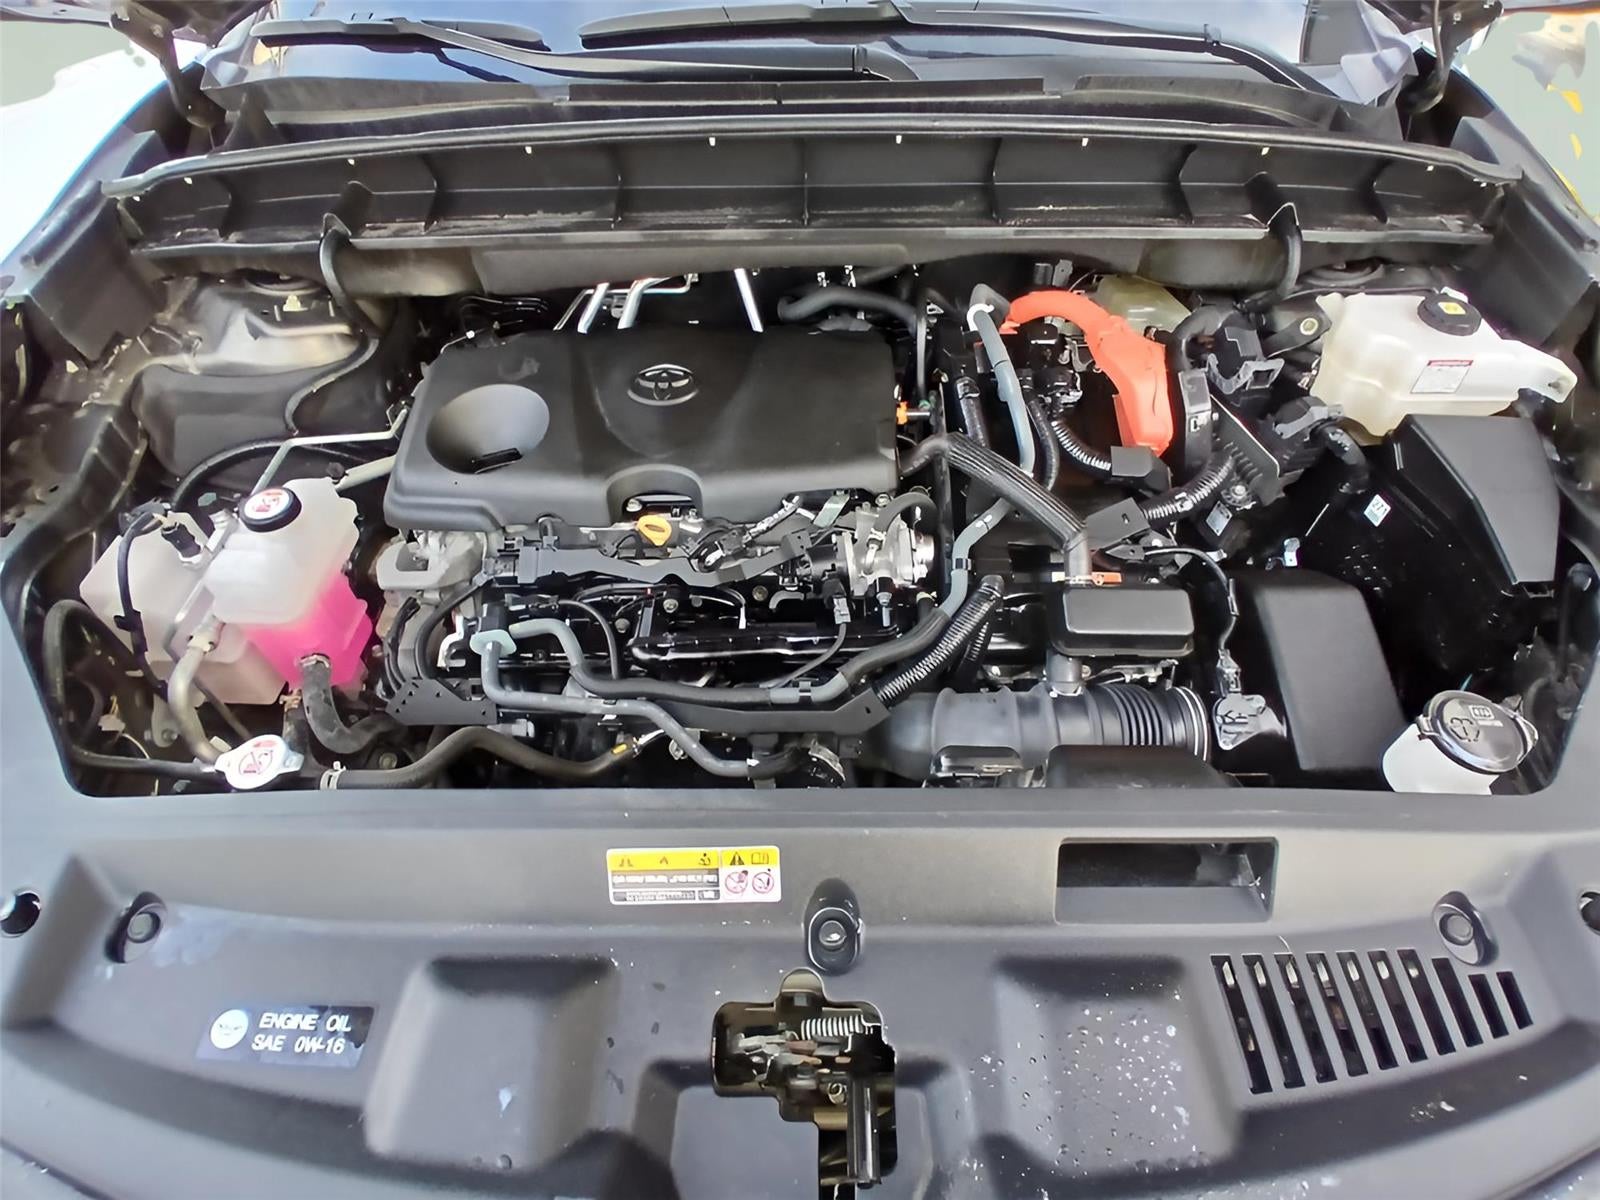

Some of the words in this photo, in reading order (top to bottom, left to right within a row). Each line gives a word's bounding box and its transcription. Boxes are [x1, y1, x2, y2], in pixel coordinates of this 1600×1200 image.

[258, 1012, 320, 1031] ENGINE
[326, 1014, 352, 1032] OIL
[251, 1033, 287, 1052] SAE
[294, 1036, 346, 1055] 0W-16
